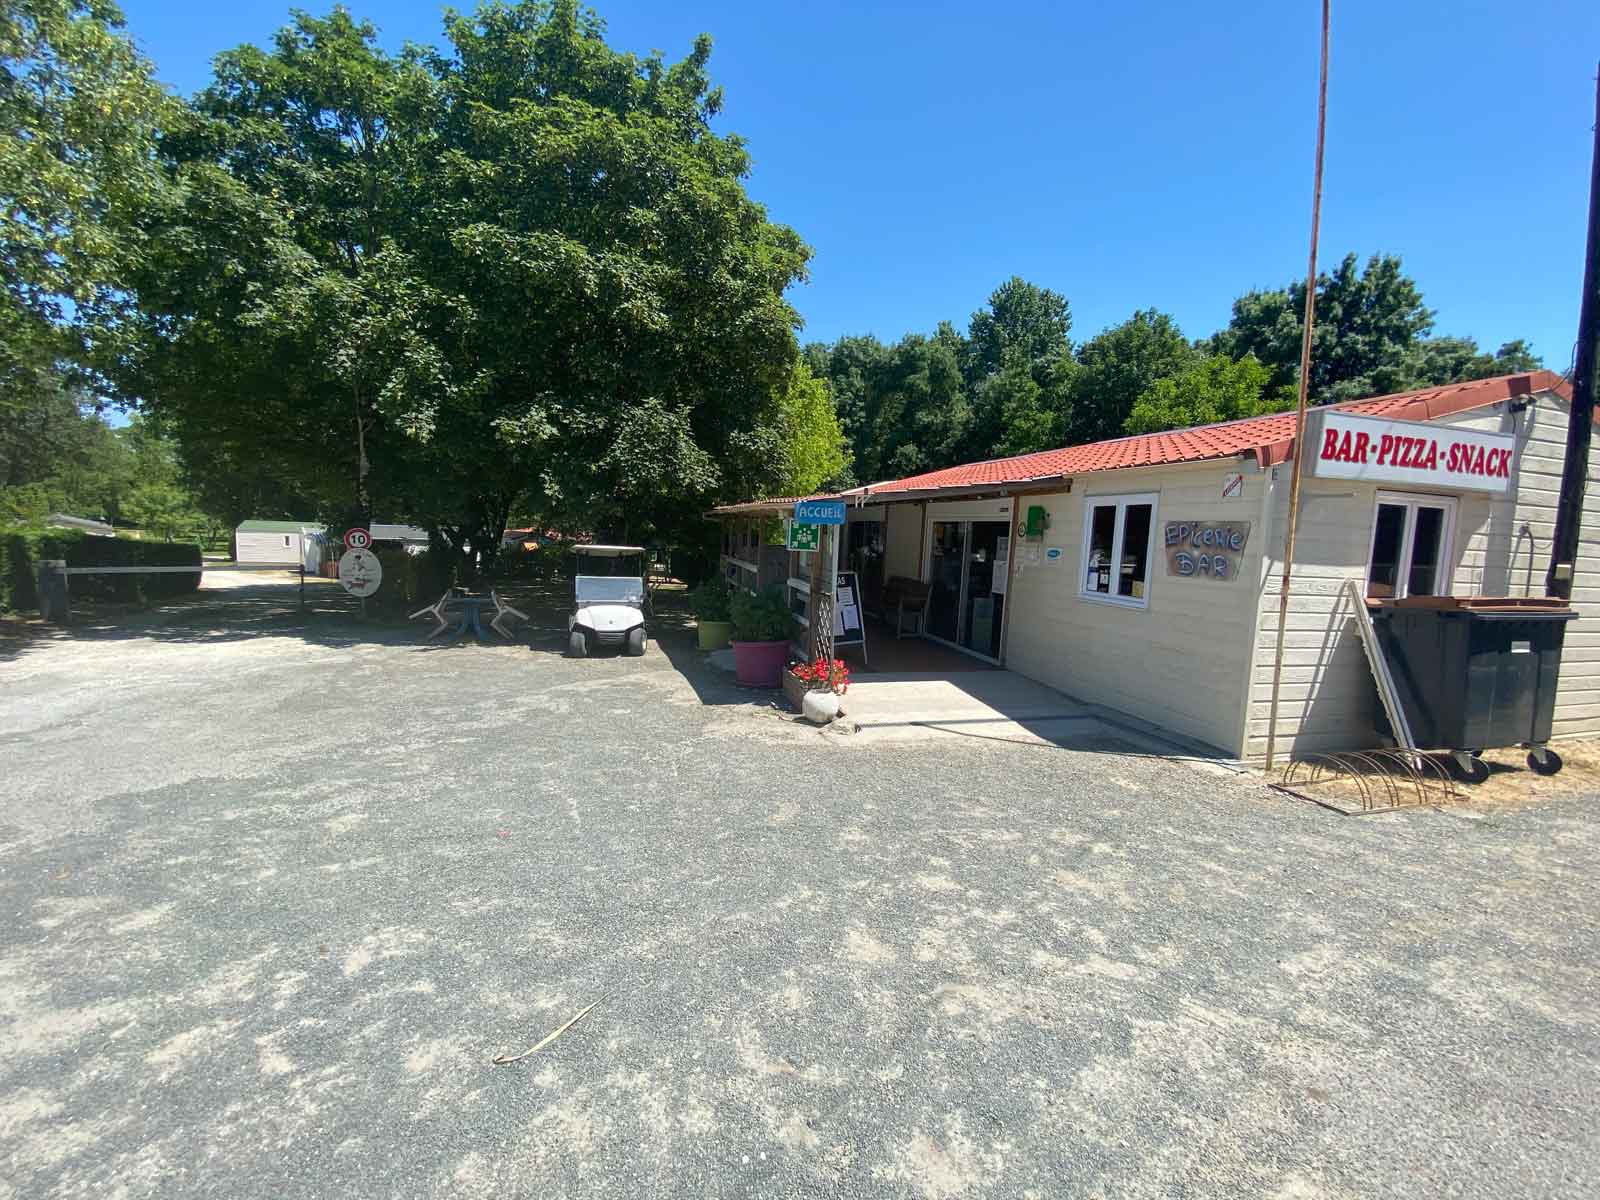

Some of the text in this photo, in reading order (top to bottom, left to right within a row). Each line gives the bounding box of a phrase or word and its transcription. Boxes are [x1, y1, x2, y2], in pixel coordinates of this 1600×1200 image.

[1320, 428, 1512, 479] BAR PIZZA SNACK
[799, 506, 842, 518] ACCUEIL
[351, 535, 366, 544] 10
[1175, 553, 1228, 576] BAR
